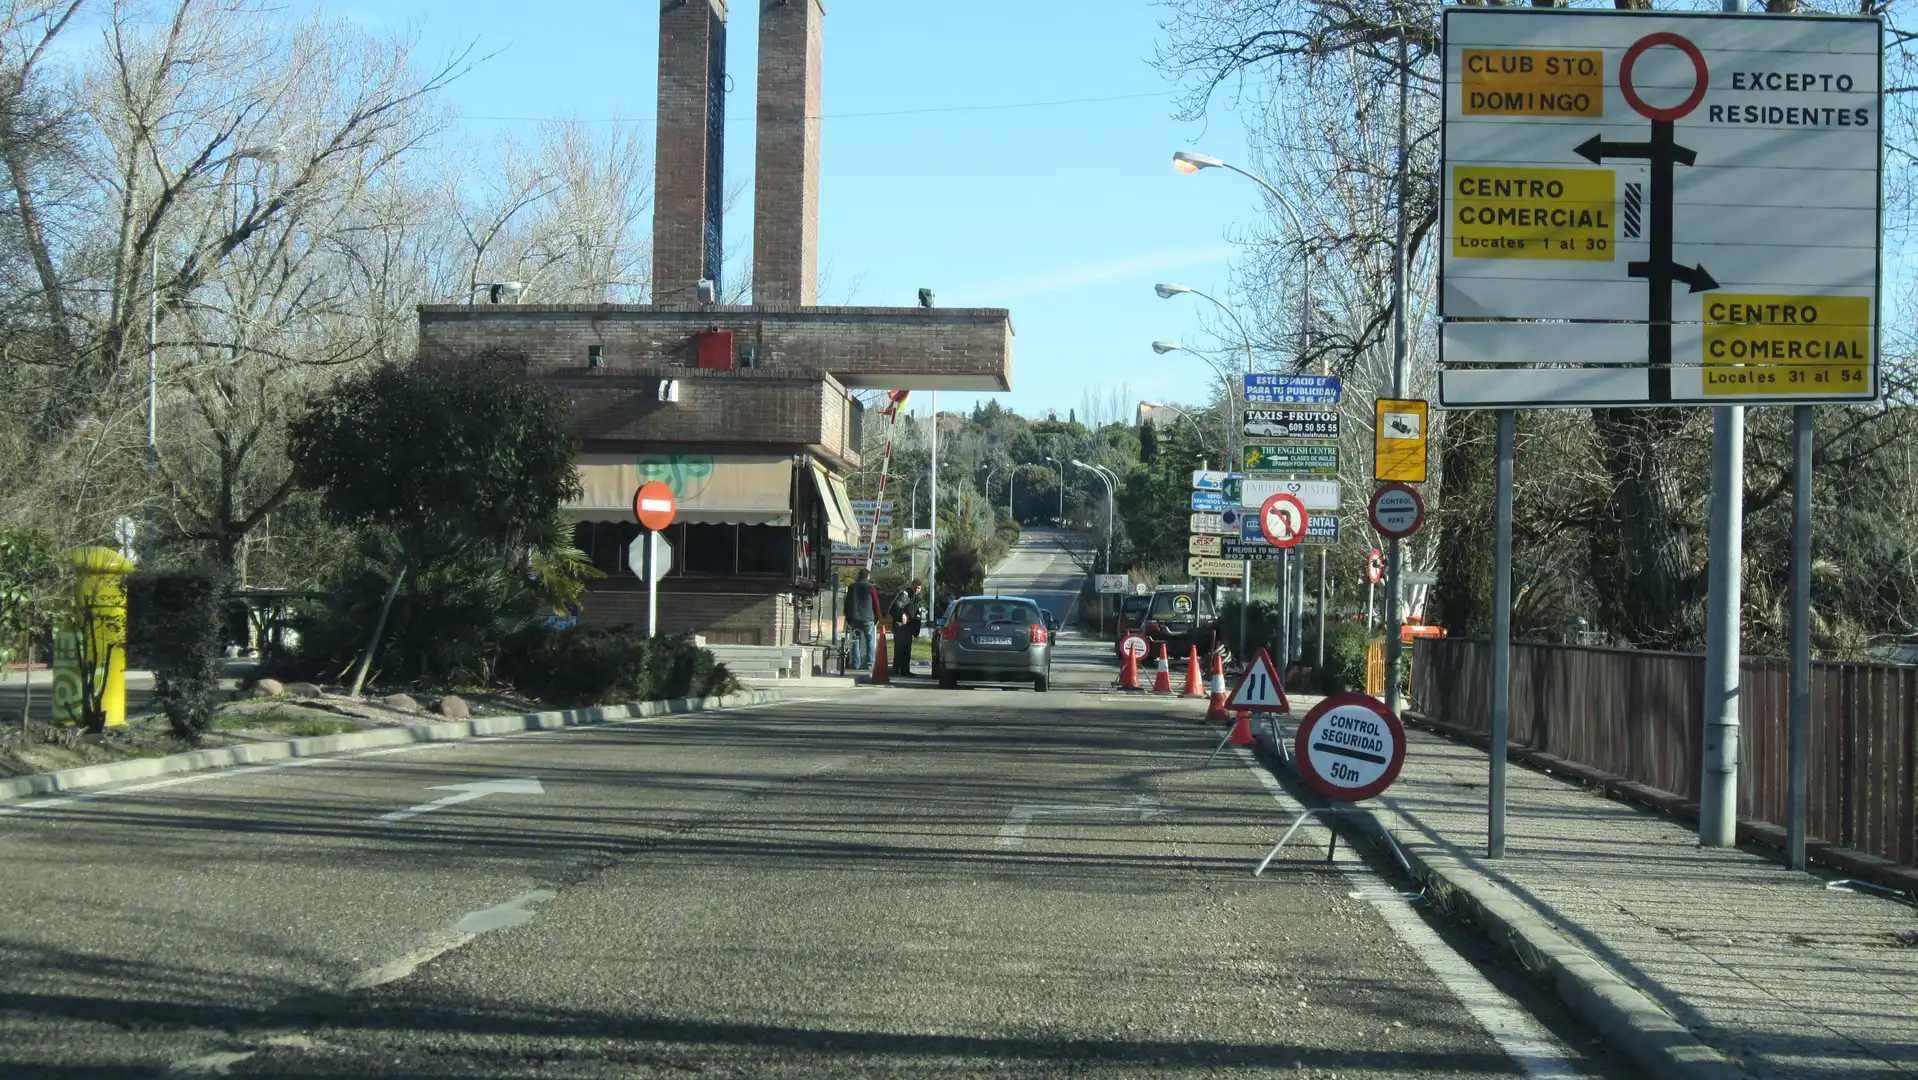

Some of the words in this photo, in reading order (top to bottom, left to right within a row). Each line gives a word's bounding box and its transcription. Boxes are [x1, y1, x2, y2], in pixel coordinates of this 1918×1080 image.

[1468, 55, 1534, 73] CLUB
[1546, 57, 1597, 76] STO.
[1732, 72, 1853, 92] EXCEPTO
[1470, 91, 1590, 112] DOMINGO
[1709, 105, 1869, 126] RESIDENTES
[1459, 177, 1564, 198] CENTRO
[1459, 206, 1609, 228] COMERCIAL
[1460, 236, 1525, 249] Locales
[1543, 238, 1549, 249] 1
[1560, 238, 1575, 250] al
[1586, 239, 1607, 250] 30
[1709, 303, 1818, 323] CENTRO
[1709, 339, 1864, 359] COMERCIAL
[1709, 371, 1776, 384] Locales
[1788, 370, 1805, 382] 31
[1815, 370, 1829, 382] al
[1841, 370, 1862, 382] 54
[1246, 386, 1270, 394] PARA
[1273, 387, 1284, 395] TU
[1287, 387, 1337, 396] PUBLICIDAD
[1246, 411, 1338, 421] TAXIS-FRUTOS
[1288, 423, 1303, 431] 609
[1305, 423, 1314, 432] 50
[1316, 424, 1326, 432] 55
[1328, 424, 1338, 432] 55
[1309, 447, 1337, 455] CENTRE
[1308, 517, 1336, 528] ENTAL
[1331, 715, 1380, 736] CONTROL
[1321, 728, 1383, 752] SEGURIDAD
[1330, 762, 1360, 783] 50m
